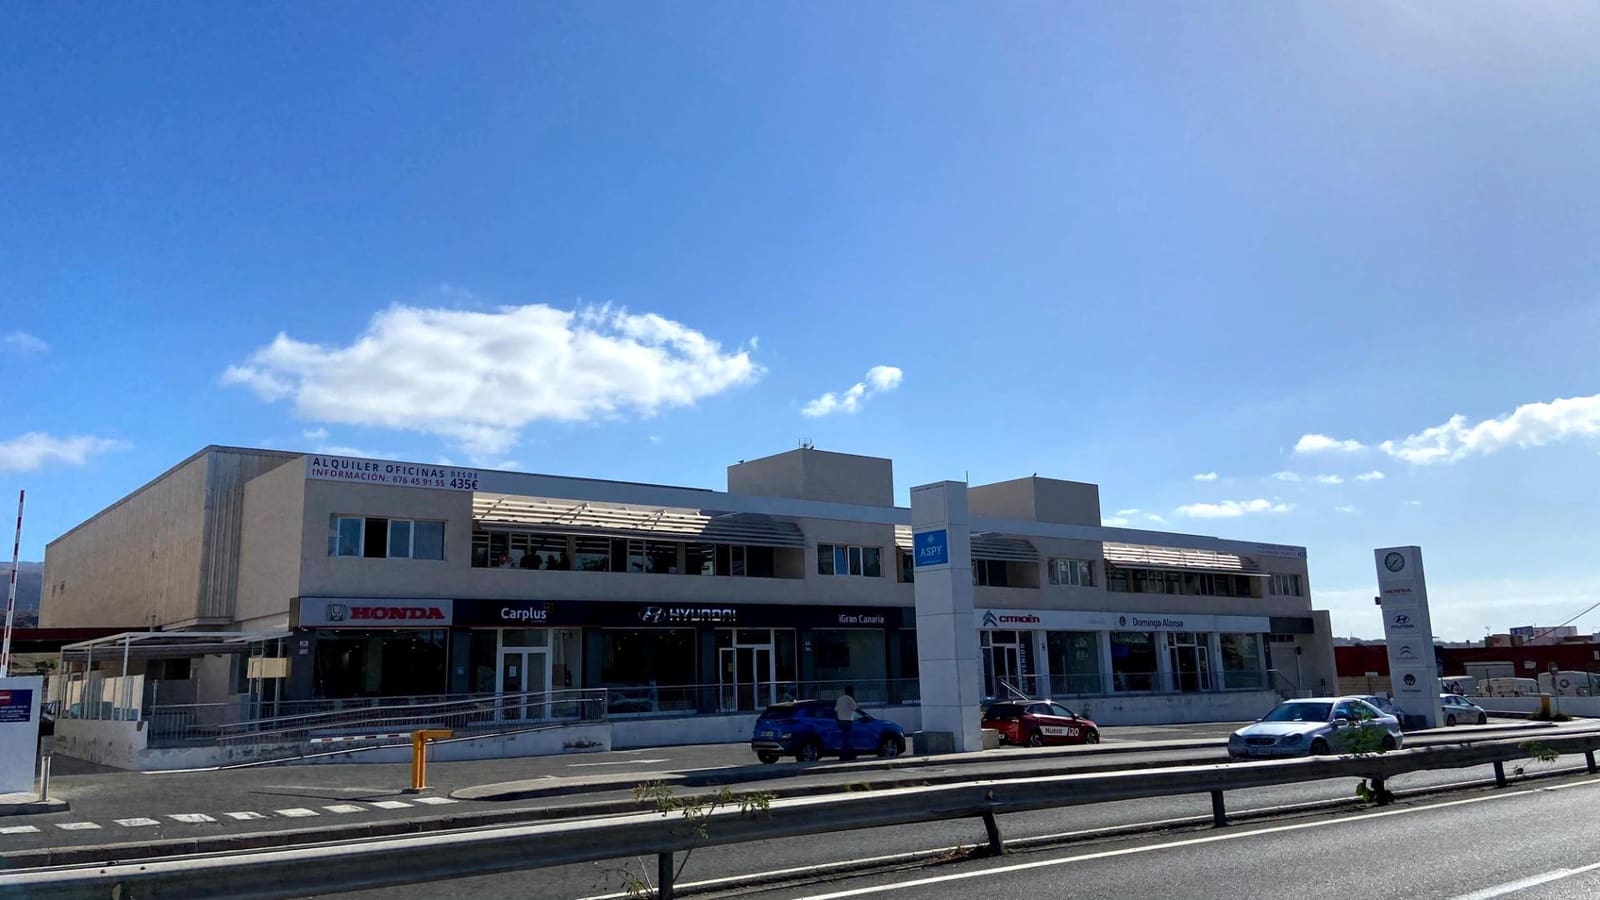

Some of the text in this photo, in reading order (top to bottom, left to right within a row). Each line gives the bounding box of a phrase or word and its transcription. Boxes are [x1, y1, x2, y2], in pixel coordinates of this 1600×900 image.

[313, 457, 446, 478] ALQUILER OFICINAS
[392, 476, 408, 484] 676
[450, 471, 479, 480] DESDE
[449, 478, 480, 490] 435€
[920, 545, 943, 557] ASPY
[350, 607, 445, 620] HONDA
[501, 607, 547, 621] Carplus
[669, 608, 737, 622] HYUNDAI
[858, 614, 885, 625] Canaria
[1068, 727, 1080, 737] i20
